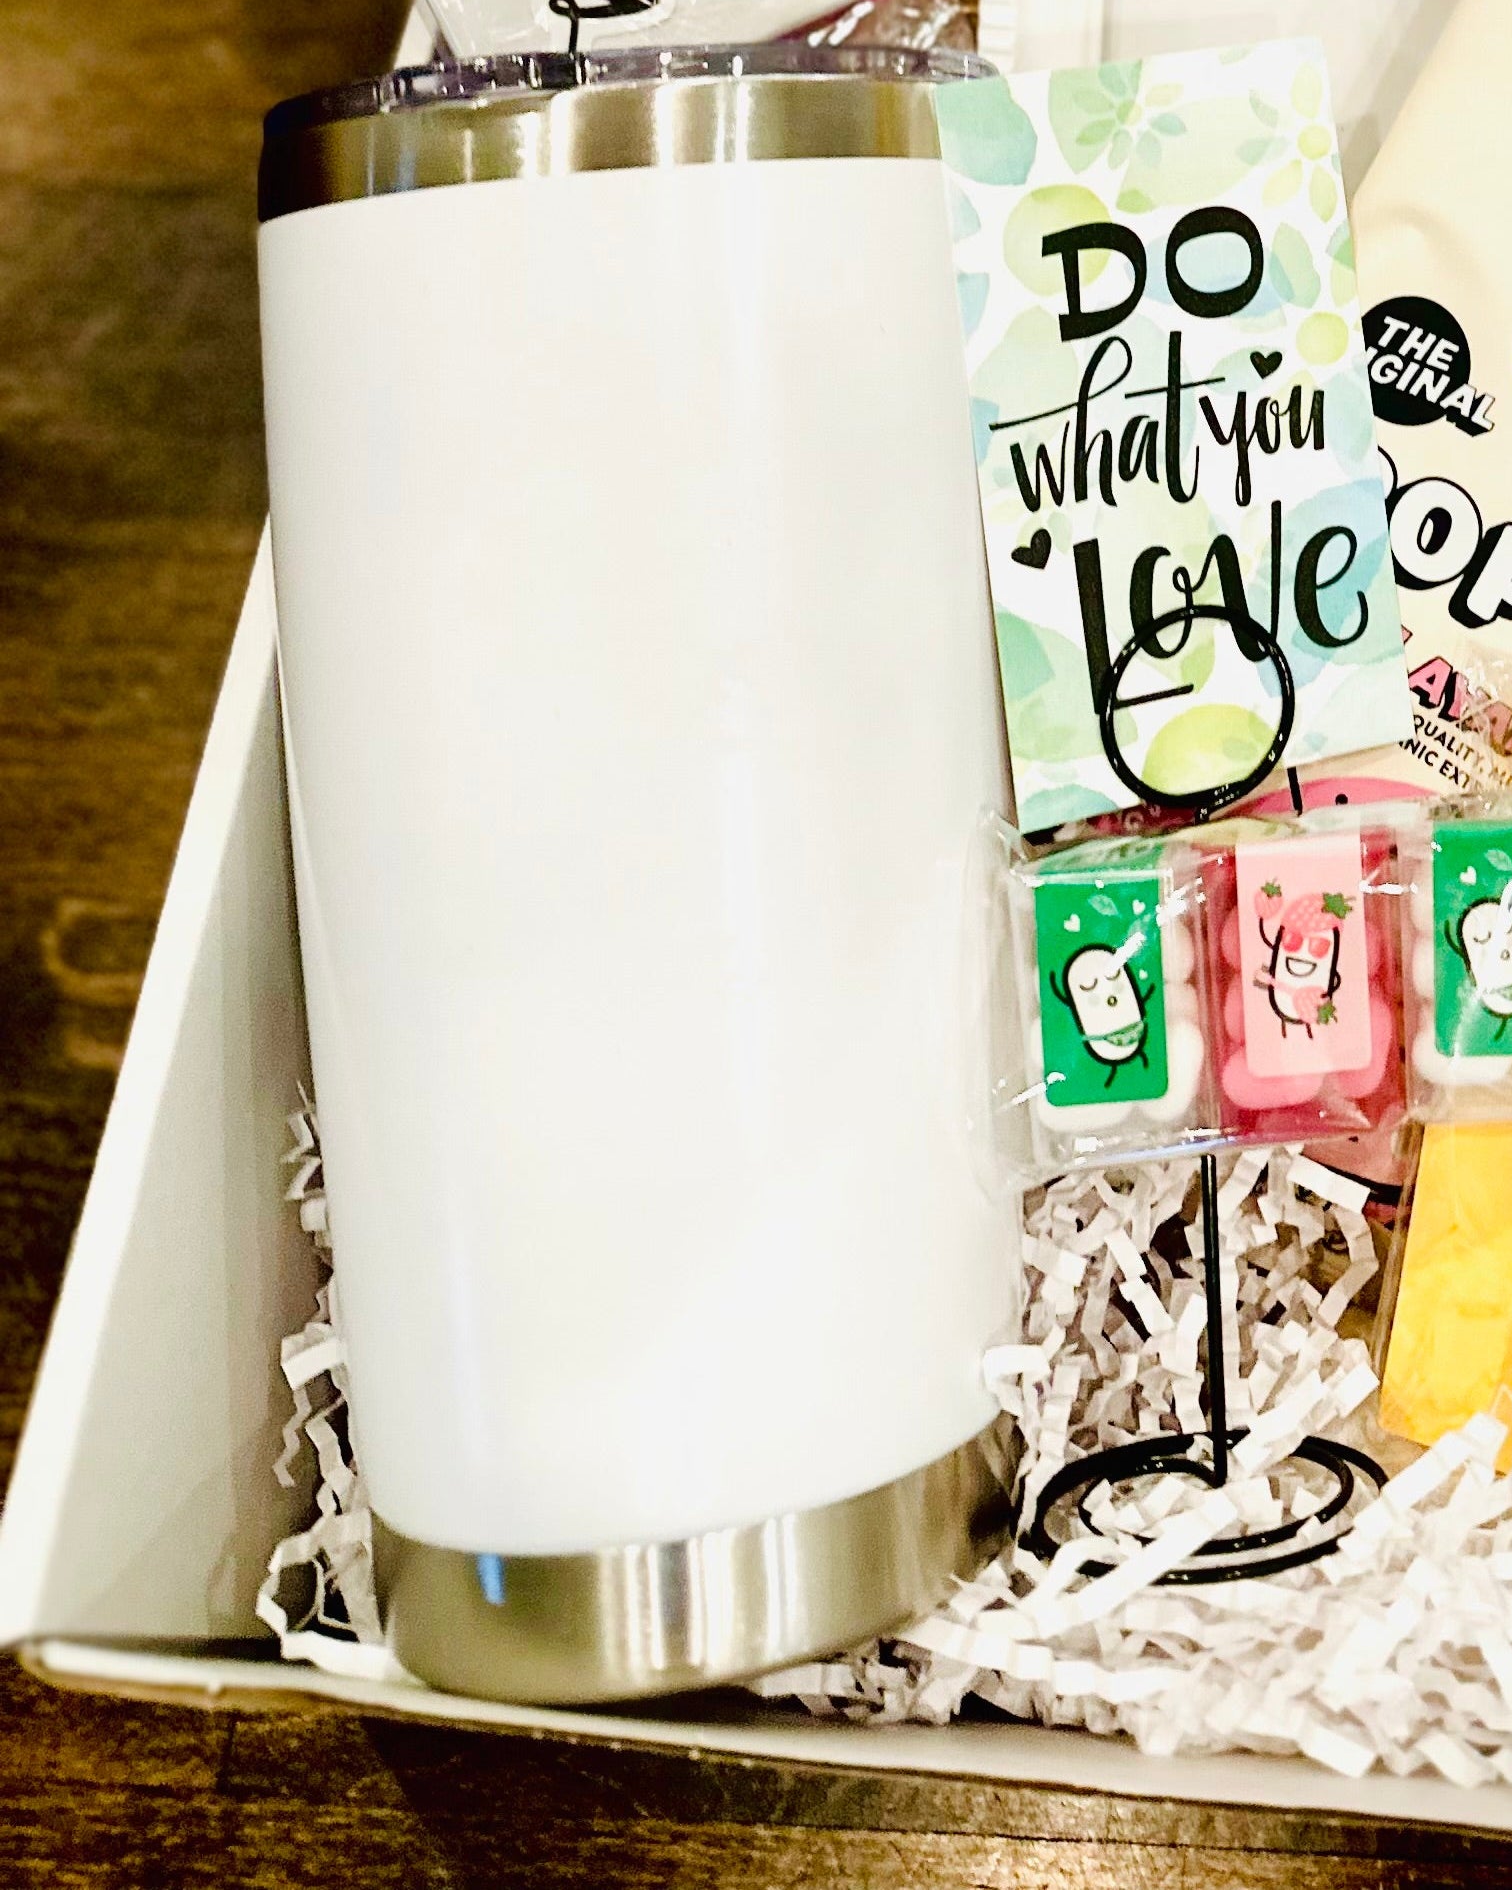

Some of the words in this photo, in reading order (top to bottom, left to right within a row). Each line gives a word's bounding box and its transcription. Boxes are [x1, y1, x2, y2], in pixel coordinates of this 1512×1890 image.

[1040, 206, 1264, 342] DO
[1377, 315, 1460, 372] THE
[988, 330, 1226, 512] what
[1199, 380, 1326, 508] you
